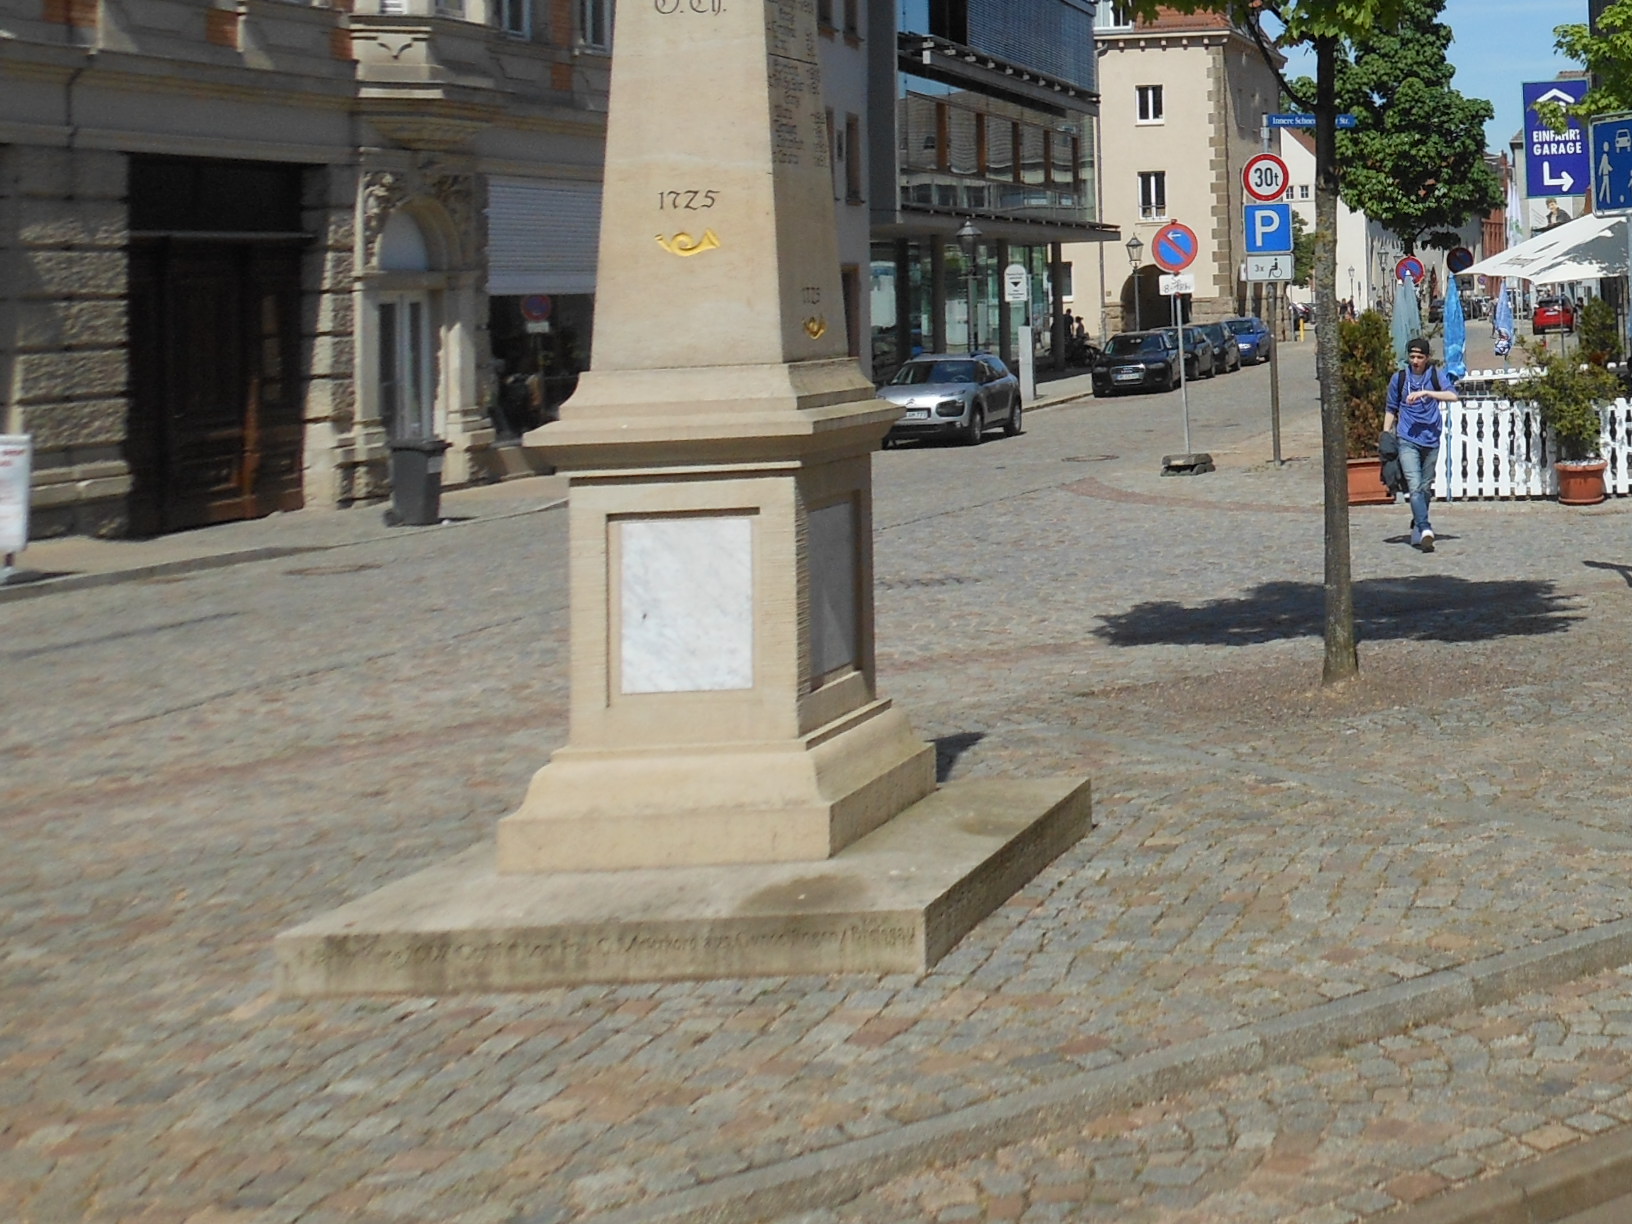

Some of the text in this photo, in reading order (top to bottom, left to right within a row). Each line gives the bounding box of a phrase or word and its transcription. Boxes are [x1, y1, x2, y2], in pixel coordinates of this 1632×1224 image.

[1533, 142, 1582, 156] GARAGE
[657, 190, 720, 210] 1725
[1254, 209, 1280, 247] P
